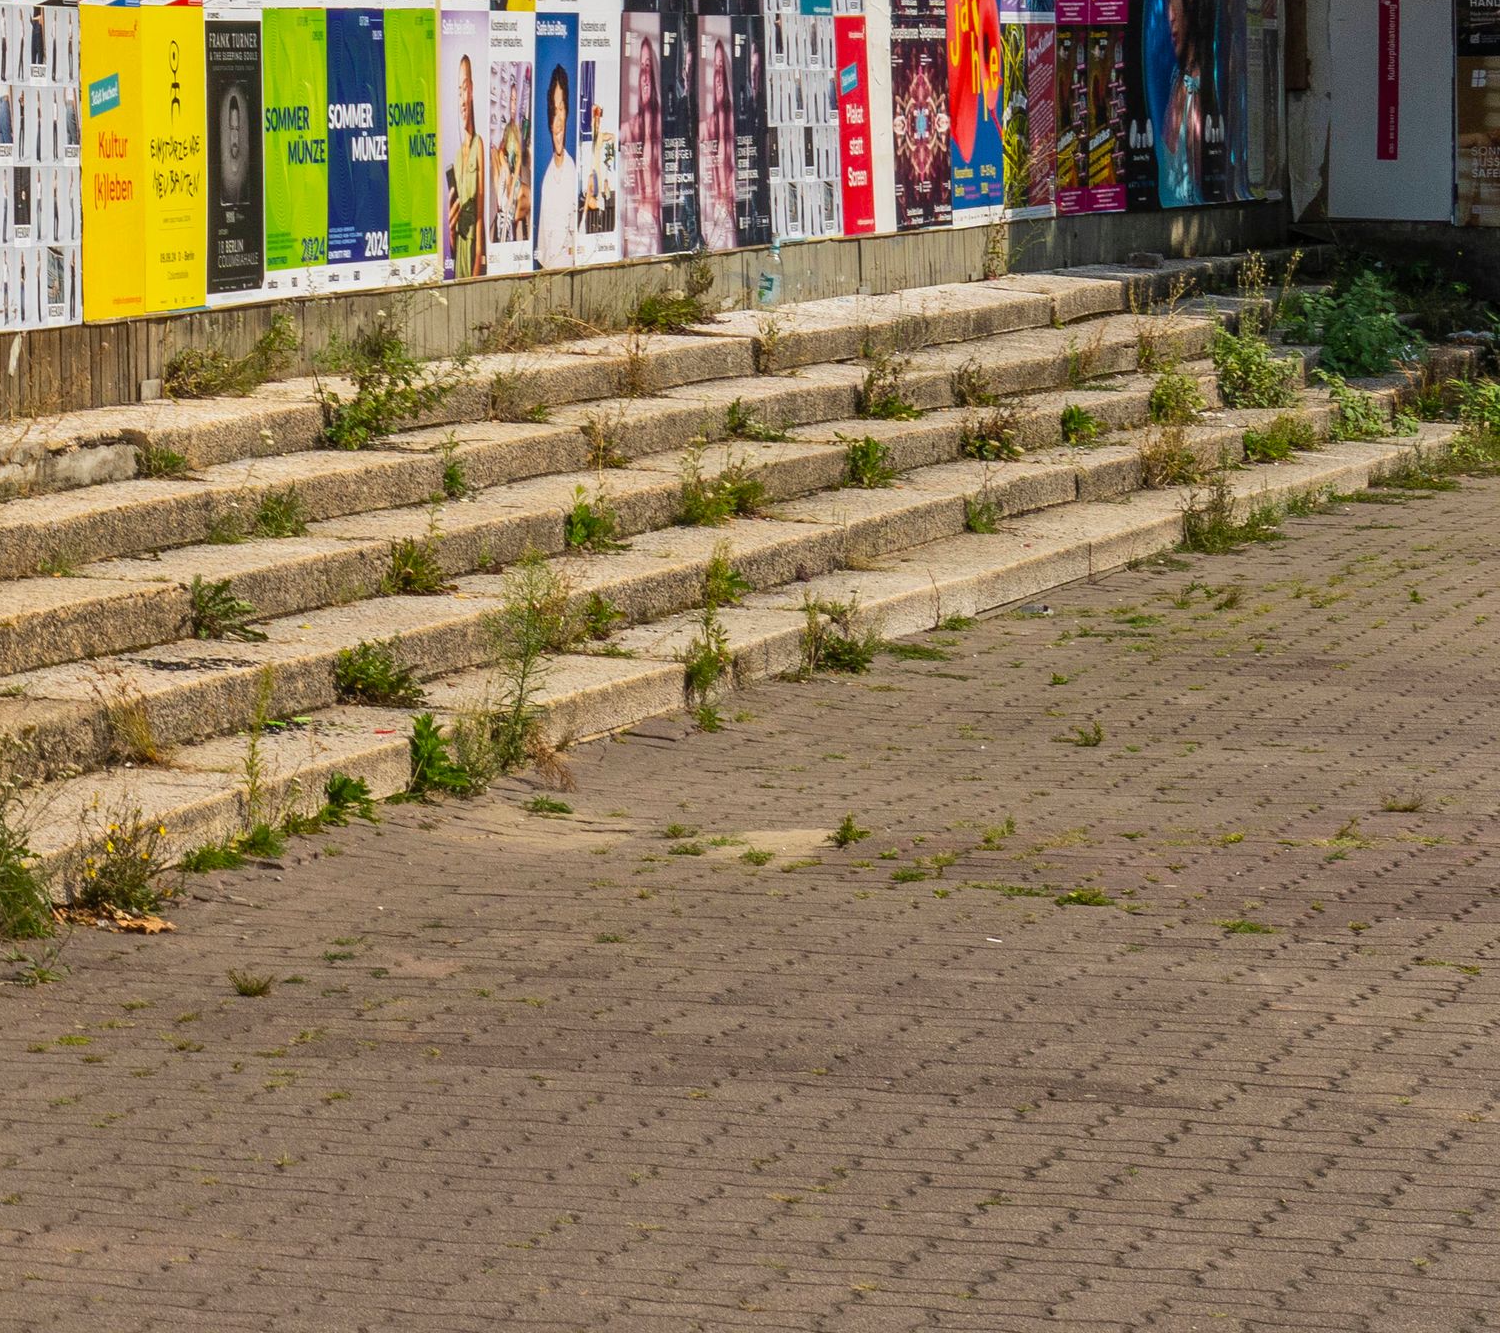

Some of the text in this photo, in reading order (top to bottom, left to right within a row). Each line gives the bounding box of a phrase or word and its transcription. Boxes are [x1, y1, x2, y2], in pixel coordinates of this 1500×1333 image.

[208, 32, 258, 49] FRANK TURNER
[328, 103, 374, 130] SOMMER
[846, 103, 864, 125] Plakat
[98, 132, 128, 159] Kultur
[352, 131, 388, 161] MÜNZE
[849, 137, 864, 156] statt
[848, 167, 868, 187] Screen
[94, 173, 133, 210] (k)leben
[364, 231, 388, 257] 2024
